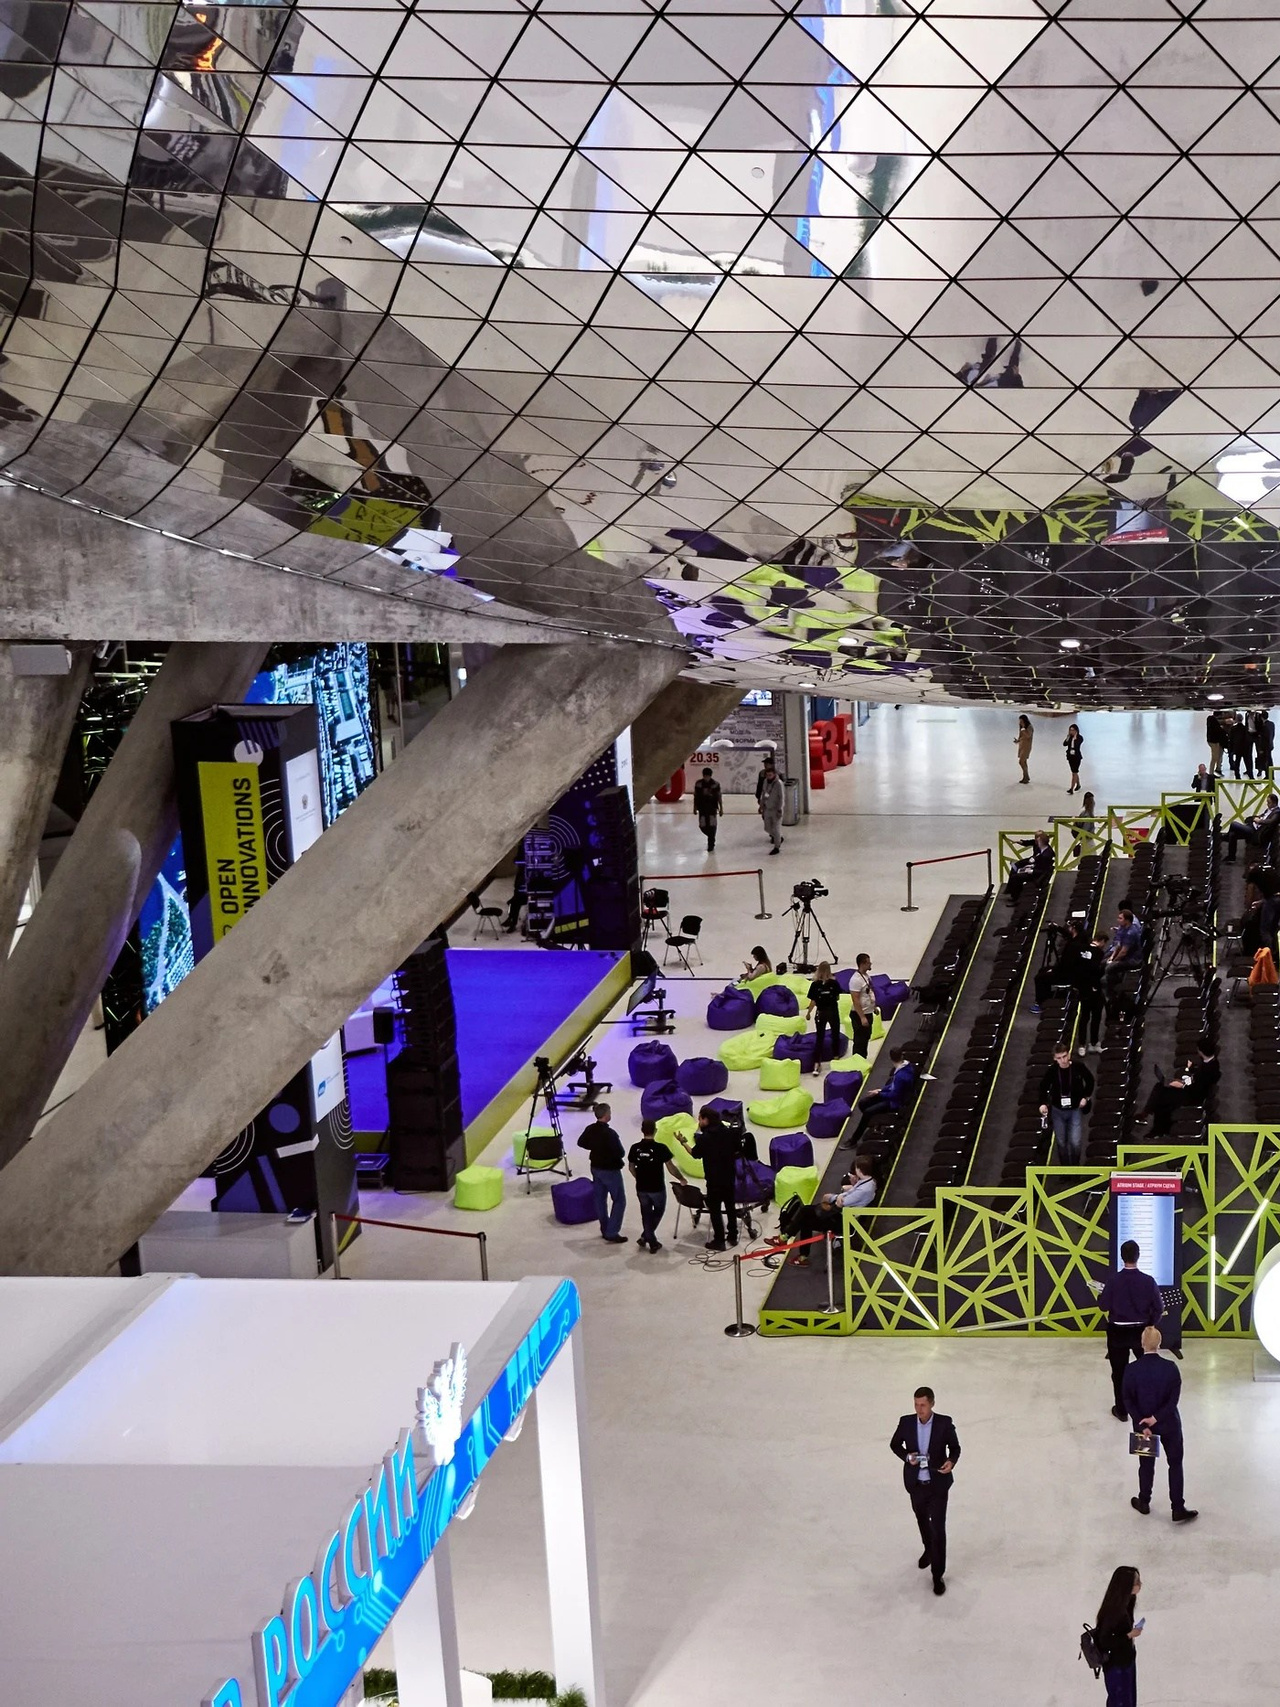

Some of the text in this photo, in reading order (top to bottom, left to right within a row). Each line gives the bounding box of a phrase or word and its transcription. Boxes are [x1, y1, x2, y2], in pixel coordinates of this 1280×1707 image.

[690, 752, 719, 763] 20.35
[217, 858, 239, 914] OPEN
[233, 777, 261, 914] NNOVATIONS
[257, 1428, 419, 1707] РОССИИ
